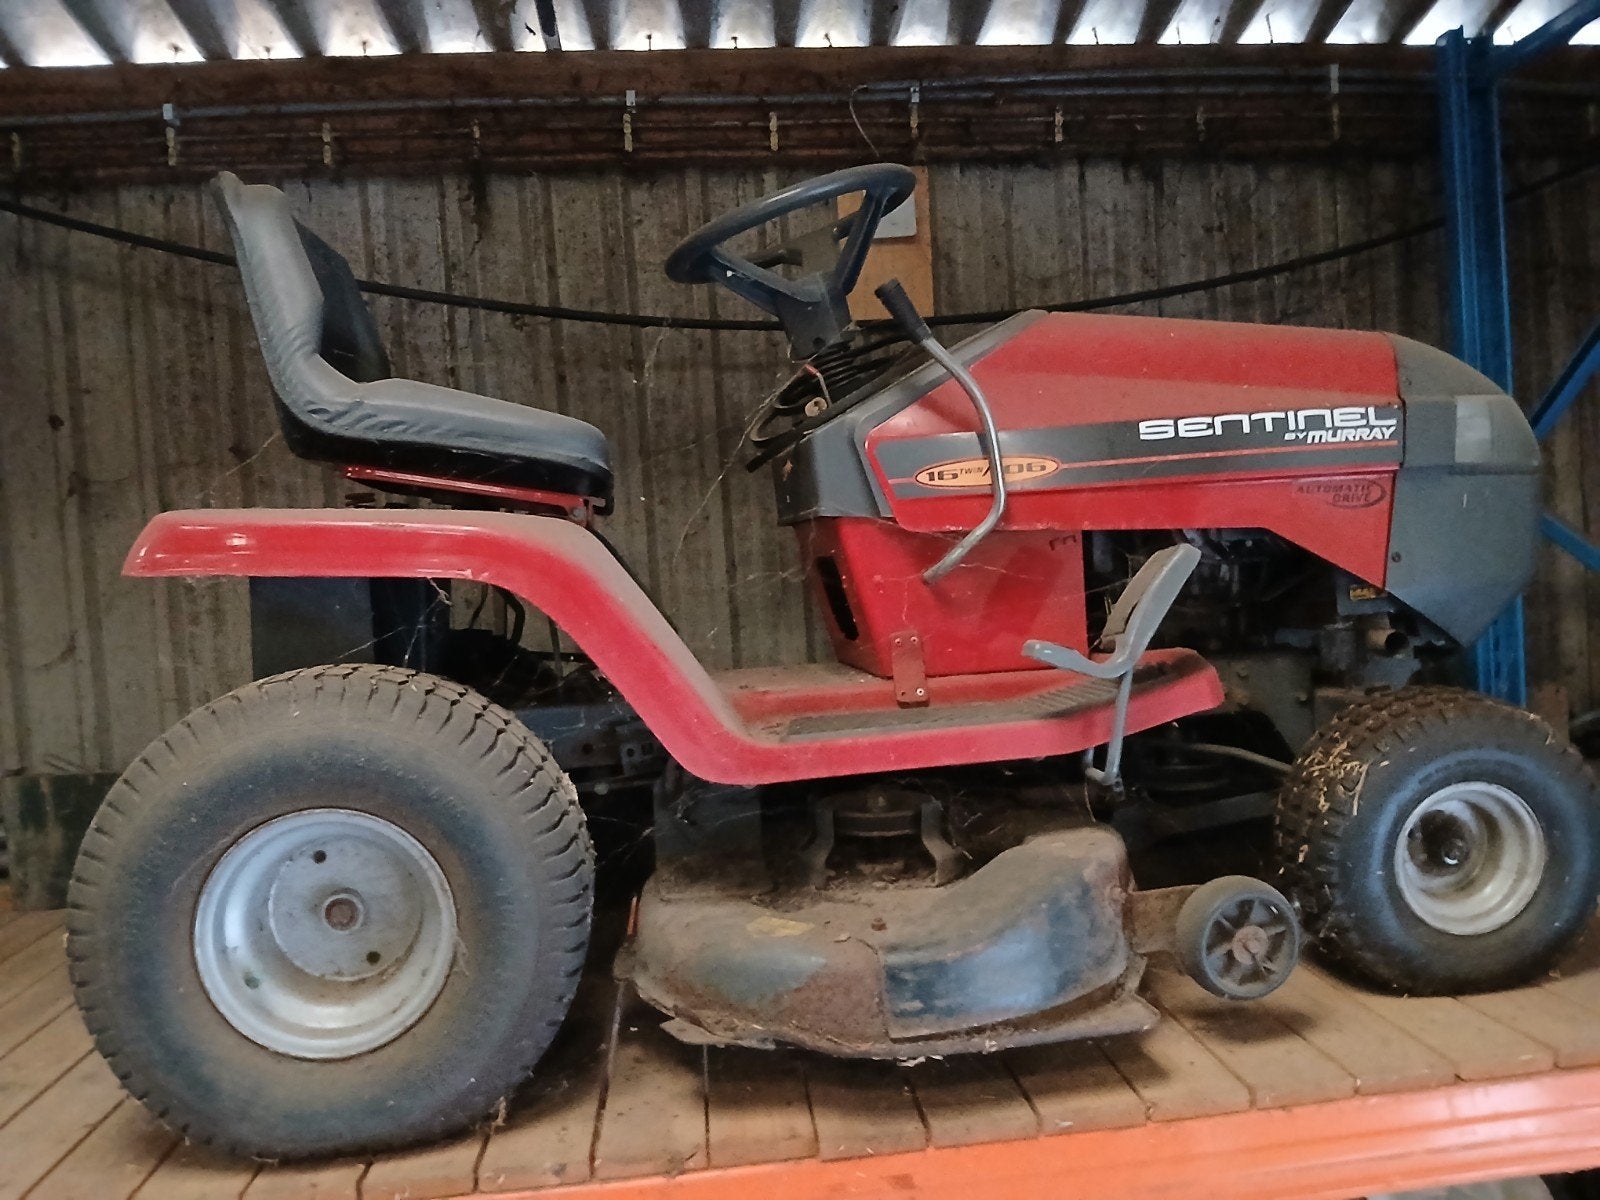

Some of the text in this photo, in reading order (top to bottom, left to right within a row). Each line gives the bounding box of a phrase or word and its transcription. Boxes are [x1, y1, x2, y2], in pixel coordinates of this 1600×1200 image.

[1138, 406, 1398, 441] SENTINEL
[1306, 425, 1396, 445] MURRAY
[926, 470, 959, 482] 16
